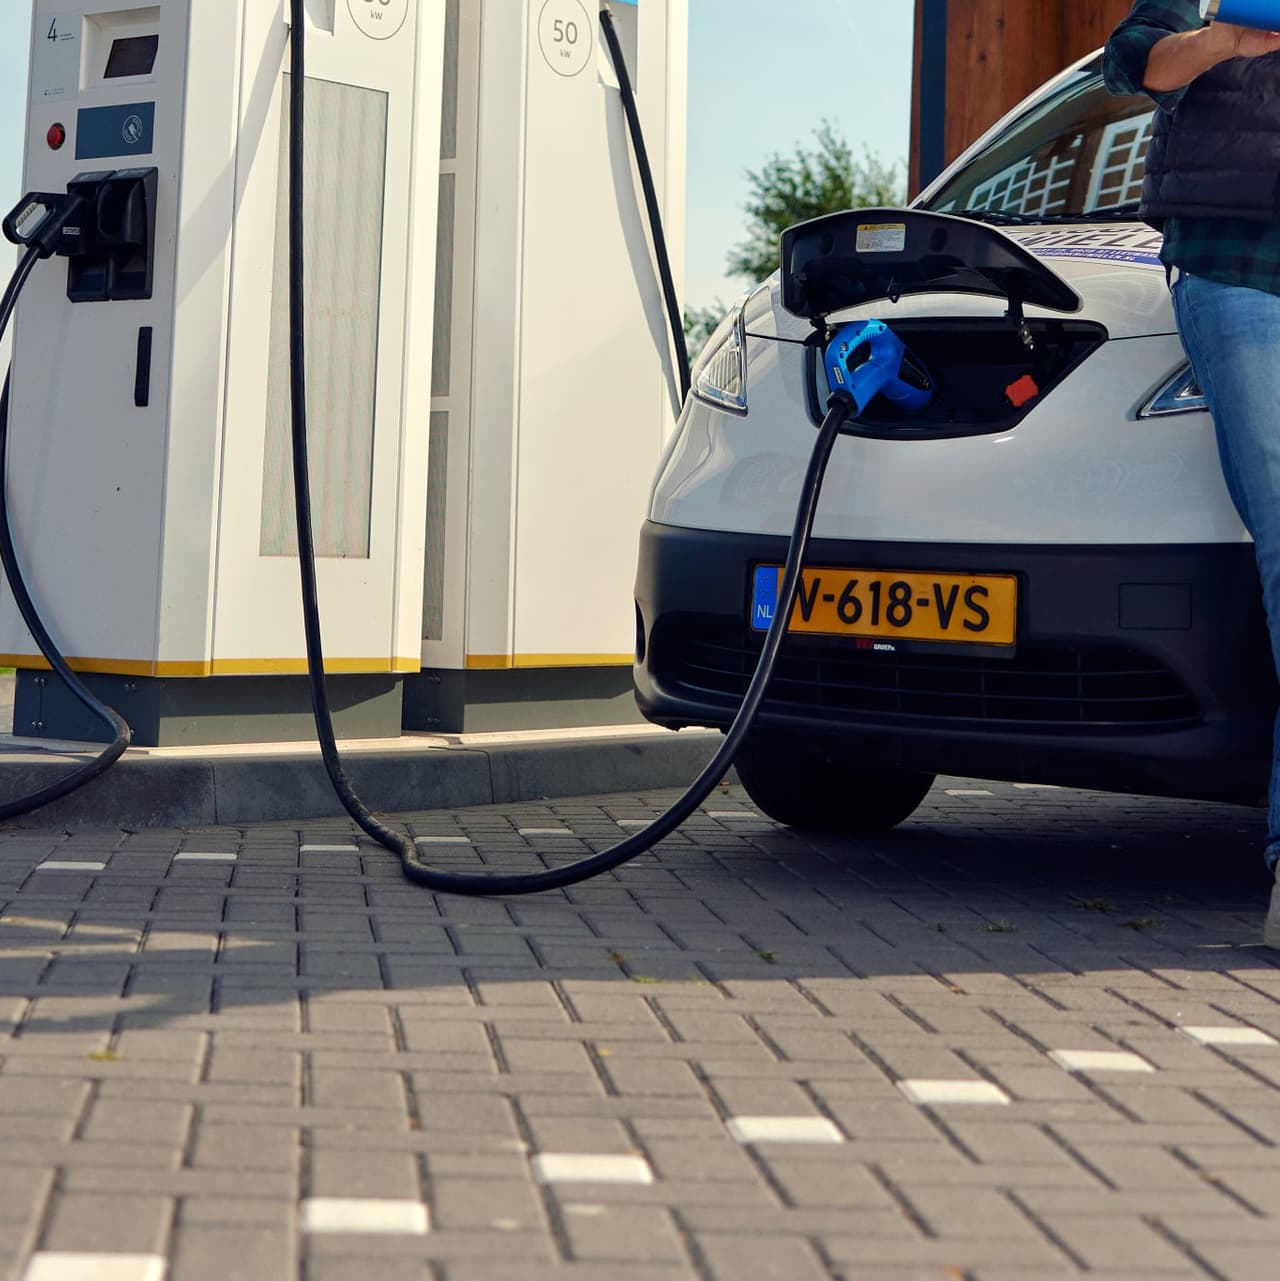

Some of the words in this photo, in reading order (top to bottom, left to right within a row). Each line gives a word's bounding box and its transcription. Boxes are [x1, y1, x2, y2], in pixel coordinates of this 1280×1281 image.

[370, 9, 383, 21] kW
[47, 17, 58, 43] 4
[552, 19, 578, 45] 50
[559, 48, 571, 59] kW
[757, 606, 773, 619] NL
